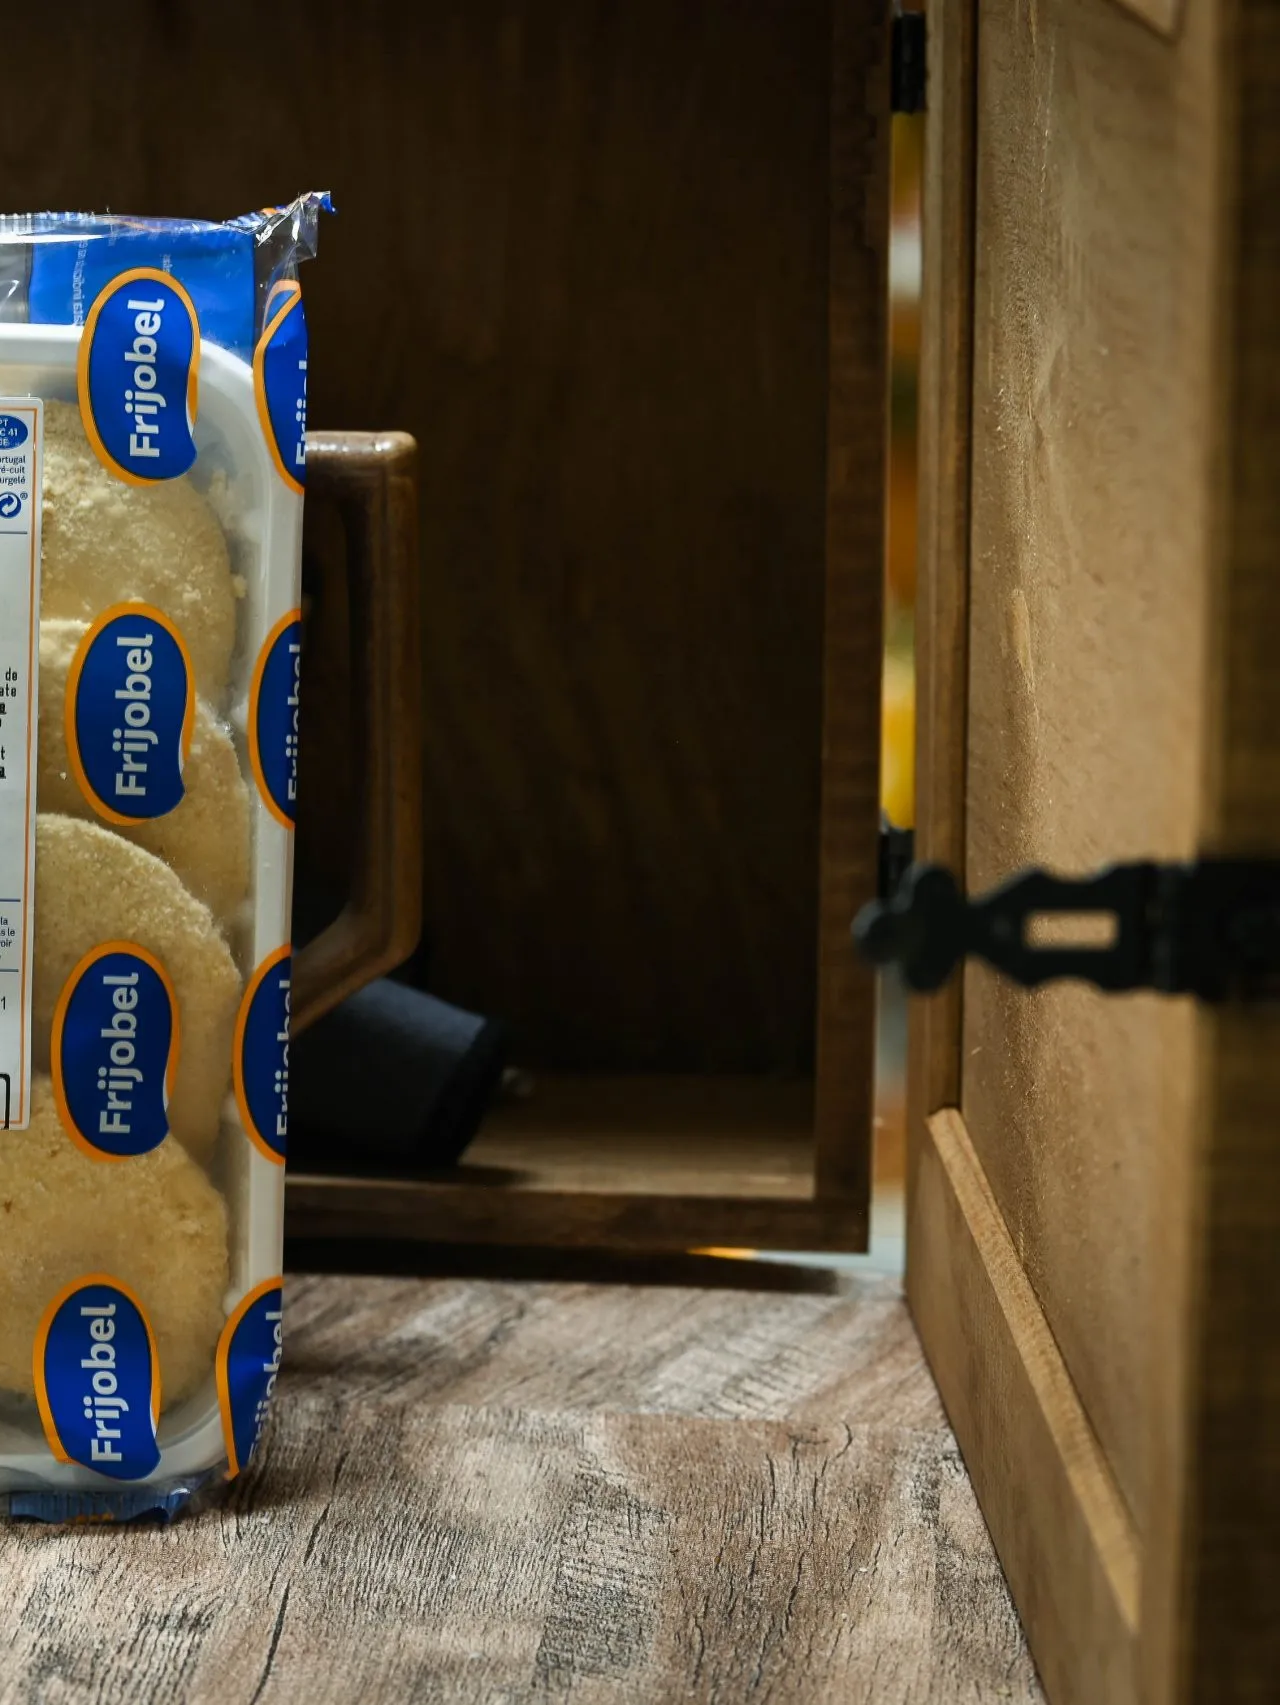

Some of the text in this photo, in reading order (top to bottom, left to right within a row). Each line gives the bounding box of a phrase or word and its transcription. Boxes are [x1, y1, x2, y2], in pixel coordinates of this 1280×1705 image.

[8, 428, 18, 436] 41
[125, 299, 166, 457] Frijobel
[5, 668, 18, 681] de
[113, 634, 158, 796] Frijobel
[97, 973, 143, 1133] Frijobel
[80, 1304, 129, 1462] Frijobel
